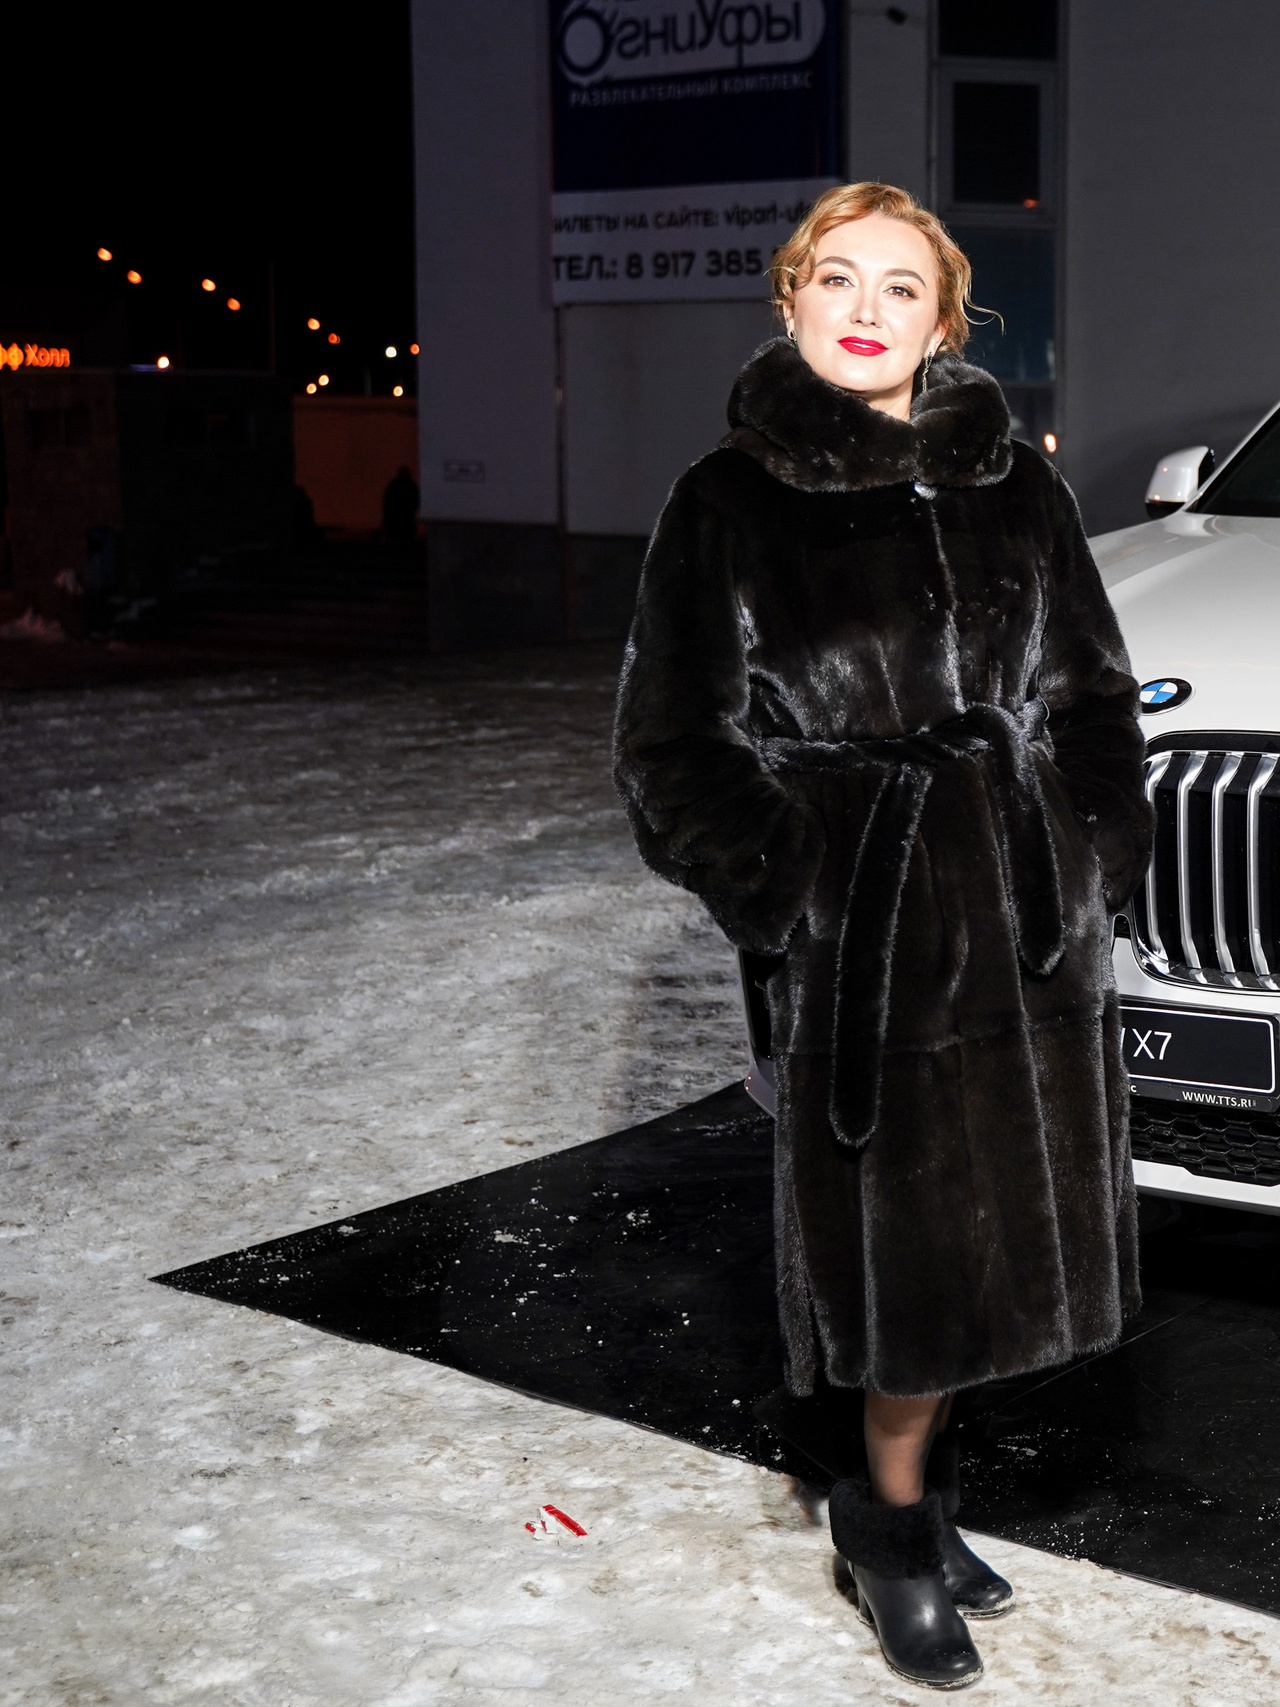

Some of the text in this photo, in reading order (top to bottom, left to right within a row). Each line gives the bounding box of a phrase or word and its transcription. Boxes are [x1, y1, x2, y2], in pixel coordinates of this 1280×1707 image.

[568, 69, 814, 108] РАЗВЛЕКАТЕЛЬНЫЙ КОМПЛЕКС
[622, 213, 650, 230] НА
[654, 204, 719, 229] САЙТЕ:
[553, 253, 619, 281] ТЕЛ.:
[624, 252, 645, 279] 8
[651, 250, 698, 279] 917
[705, 247, 763, 277] 385
[1131, 1027, 1172, 1061] X7
